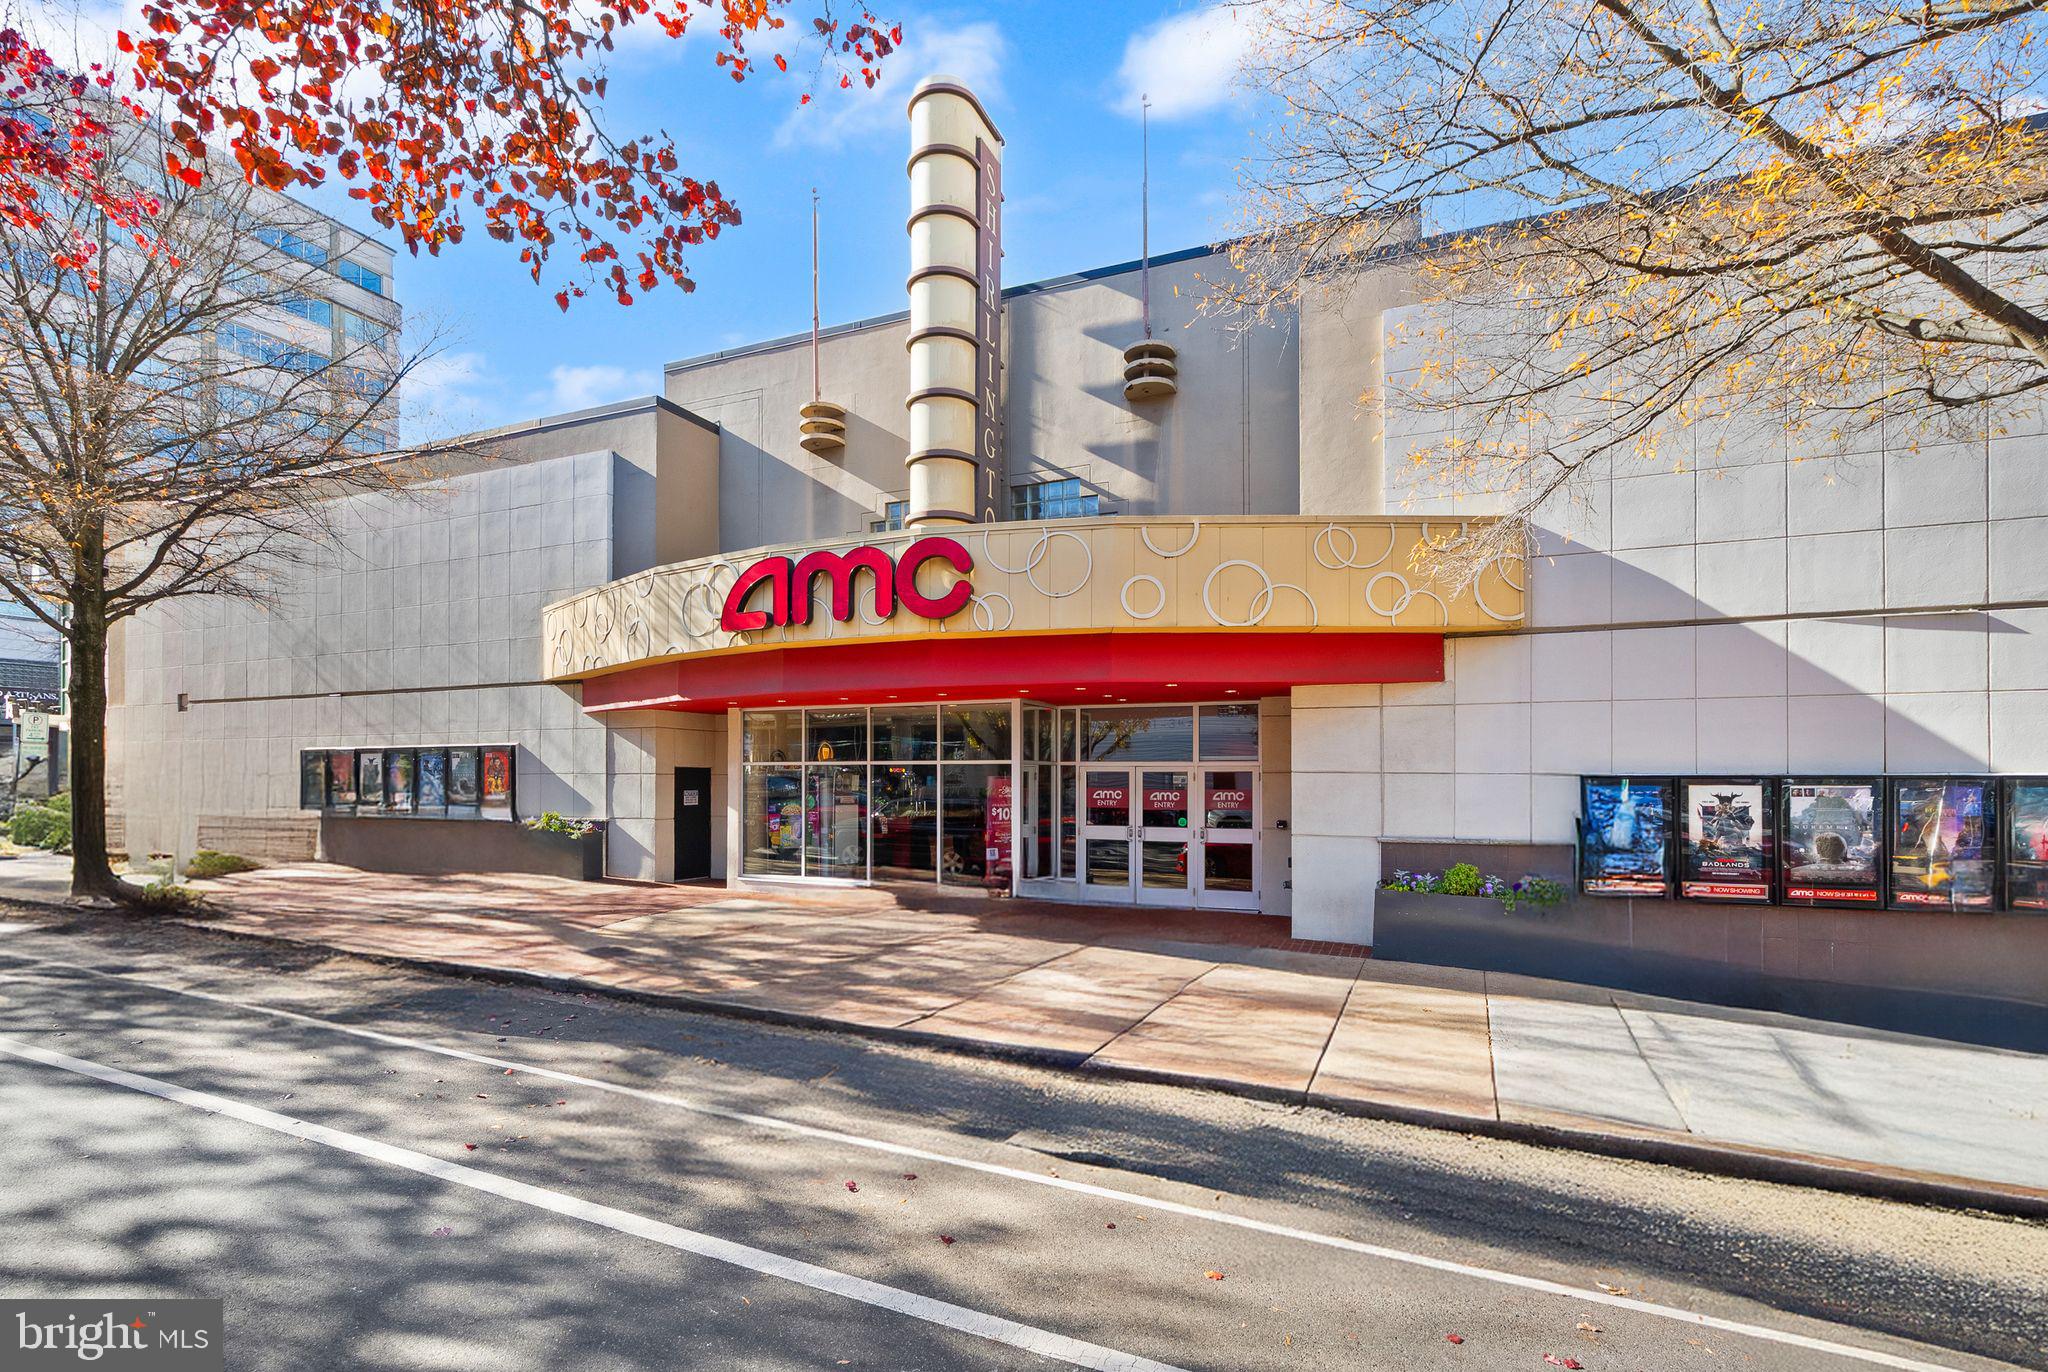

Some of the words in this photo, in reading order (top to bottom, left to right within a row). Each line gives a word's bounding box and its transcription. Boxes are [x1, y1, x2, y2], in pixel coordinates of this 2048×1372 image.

[721, 537, 974, 632] amc
[1093, 790, 1122, 800] amc
[1150, 792, 1180, 801] amc
[1213, 792, 1245, 801] amc
